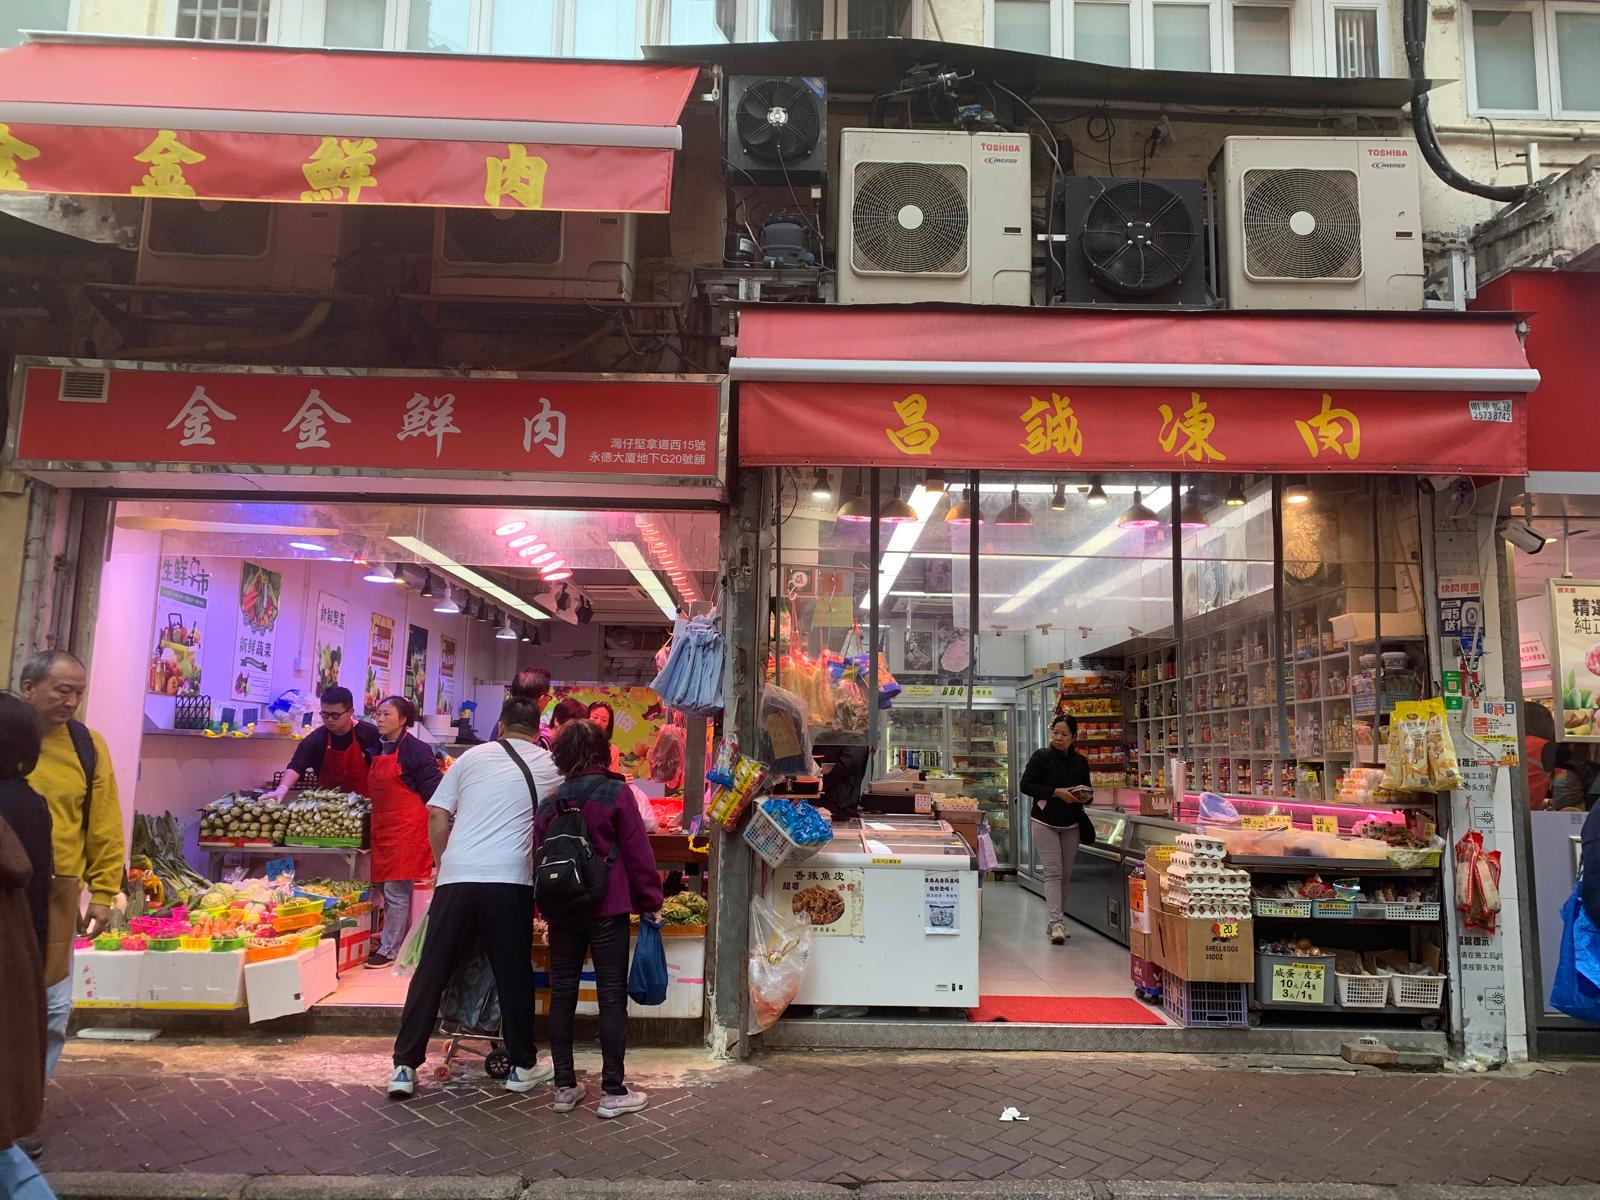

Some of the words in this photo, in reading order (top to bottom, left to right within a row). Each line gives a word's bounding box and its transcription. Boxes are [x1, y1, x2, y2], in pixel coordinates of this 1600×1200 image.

[981, 143, 1020, 152] TOSHIBA
[167, 386, 568, 459] 金金鮮肉
[886, 392, 1362, 463] 昌誠凍肉
[610, 438, 706, 452] 灣仔堅拿道西15號
[589, 451, 706, 465] 永德大廈地下G20號舖
[794, 870, 845, 881] 香辣魚皮
[1223, 924, 1233, 934] 20
